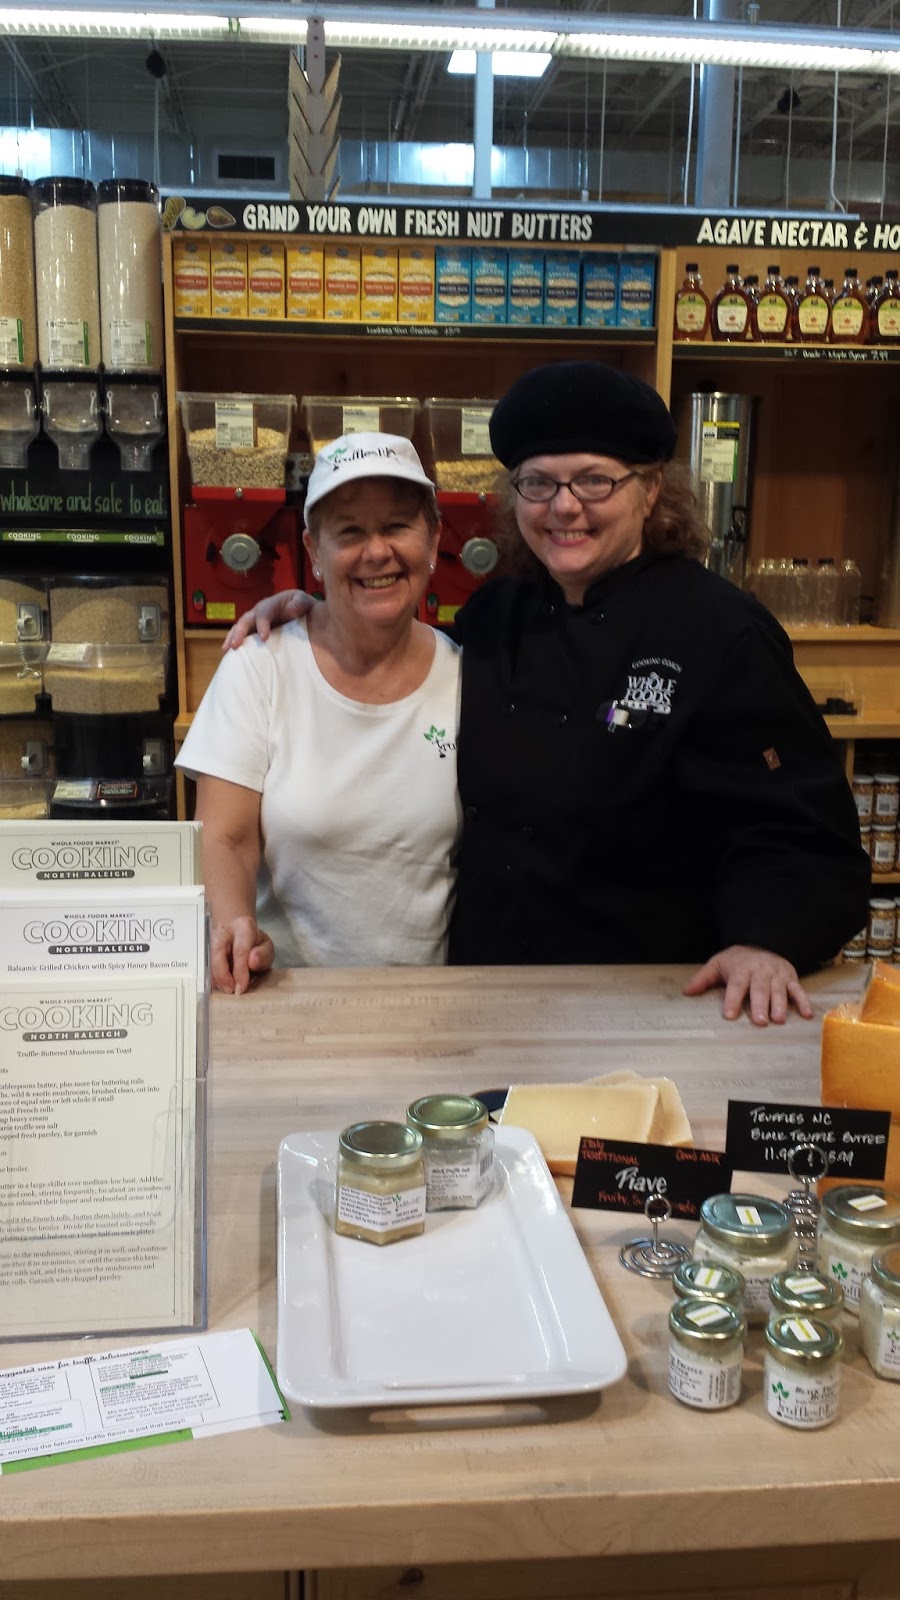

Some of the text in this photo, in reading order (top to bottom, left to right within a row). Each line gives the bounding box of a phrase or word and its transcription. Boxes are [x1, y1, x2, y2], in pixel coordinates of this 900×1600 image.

[243, 204, 593, 241] GRIND YOUR OWN FRESH NUT BUTTERS
[697, 218, 766, 246] AGAVE
[771, 220, 848, 248] NECTAR
[0, 480, 62, 512] wholesome
[67, 482, 92, 512] and
[95, 482, 122, 514] safe
[130, 483, 141, 514] to
[628, 672, 677, 693] WHOLE
[624, 688, 672, 704] FOODS
[12, 845, 158, 870] COOKING
[44, 871, 79, 879] NORTH
[23, 919, 175, 944] COOKING
[56, 945, 93, 953] NORTH
[8, 964, 38, 972] Balsamic
[91, 962, 106, 970] with
[108, 962, 126, 971] Spicy
[127, 961, 148, 970] Honey
[0, 1003, 153, 1031] COOKING
[30, 1031, 120, 1040] NORTH RALEIGH
[102, 1079, 129, 1087] buttering
[92, 1087, 116, 1095] brushed
[118, 1086, 136, 1094] clean,
[812, 1112, 832, 1126] NC
[38, 1131, 62, 1139] parsley,
[74, 1129, 97, 1137] garnish
[751, 1127, 788, 1141] BLACK
[790, 1129, 836, 1143] TRUFFLE
[31, 1182, 46, 1190] large
[615, 1166, 668, 1194] Piave
[39, 1189, 62, 1197] stirring
[74, 1248, 97, 1256] stirring
[71, 1275, 98, 1283] chopped
